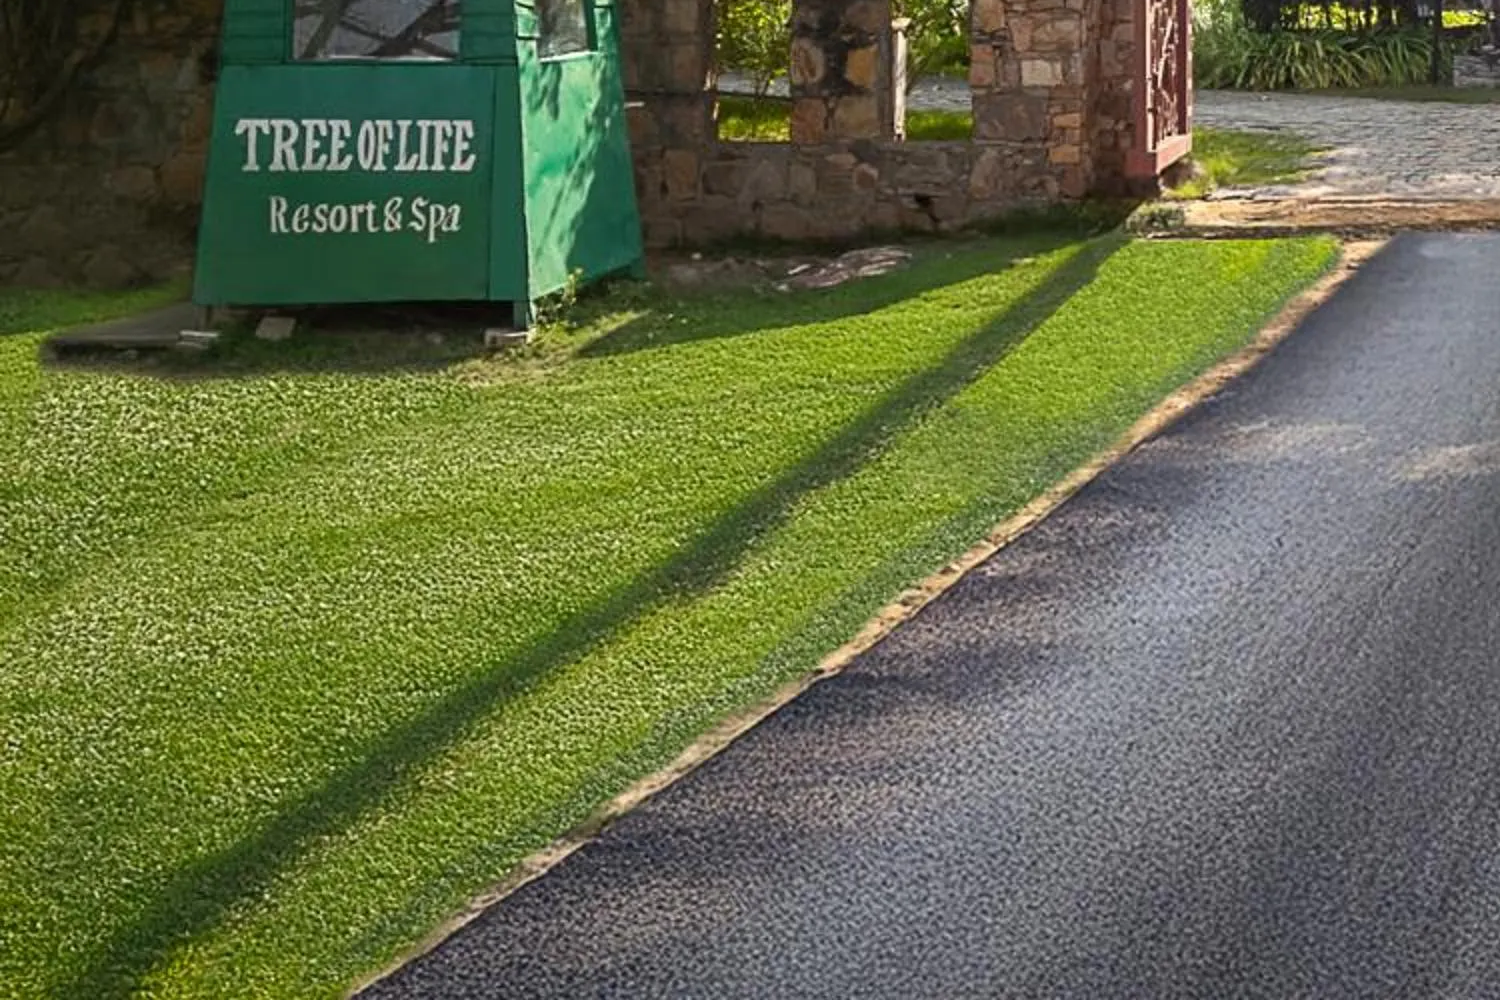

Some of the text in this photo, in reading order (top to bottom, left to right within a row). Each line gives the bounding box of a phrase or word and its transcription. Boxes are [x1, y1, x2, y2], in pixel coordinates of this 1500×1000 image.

[235, 118, 476, 172] TREE OF LIFE
[270, 196, 461, 243] Resort & Spa
